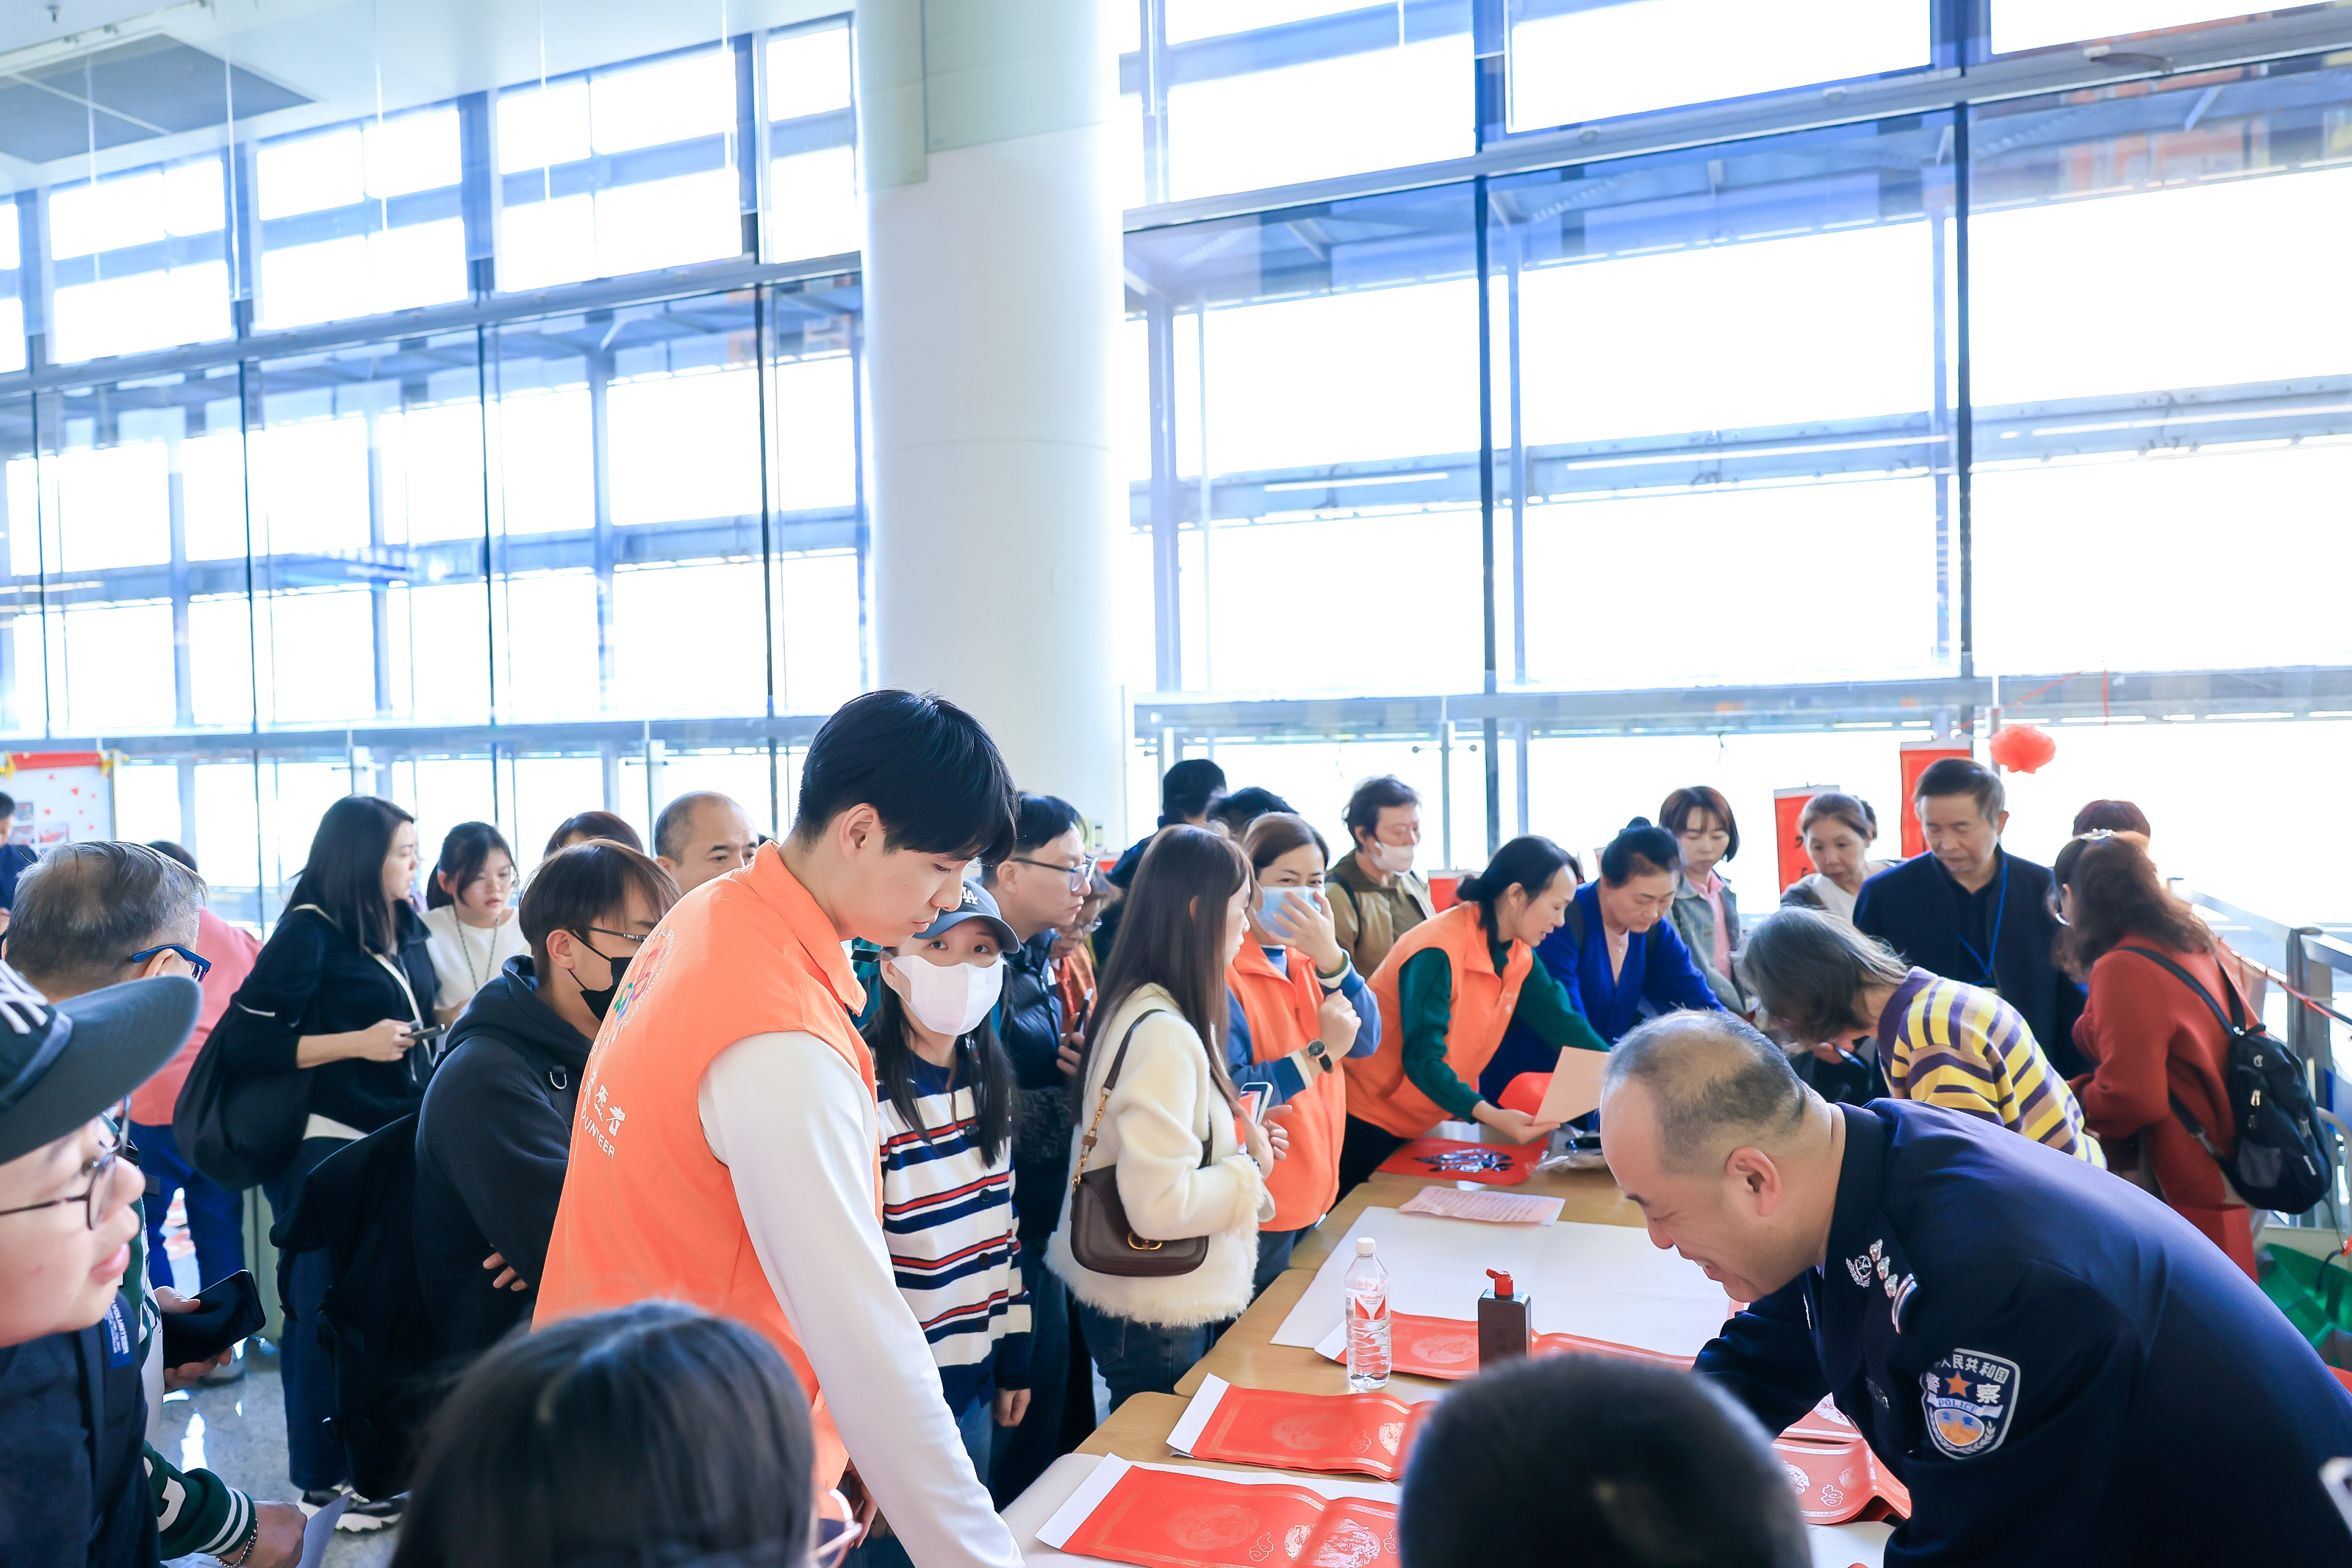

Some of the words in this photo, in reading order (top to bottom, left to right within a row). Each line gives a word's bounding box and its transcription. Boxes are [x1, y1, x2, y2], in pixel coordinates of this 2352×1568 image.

[1934, 1353, 2010, 1384] 人民共和国
[1938, 1398, 1979, 1413] POLICE
